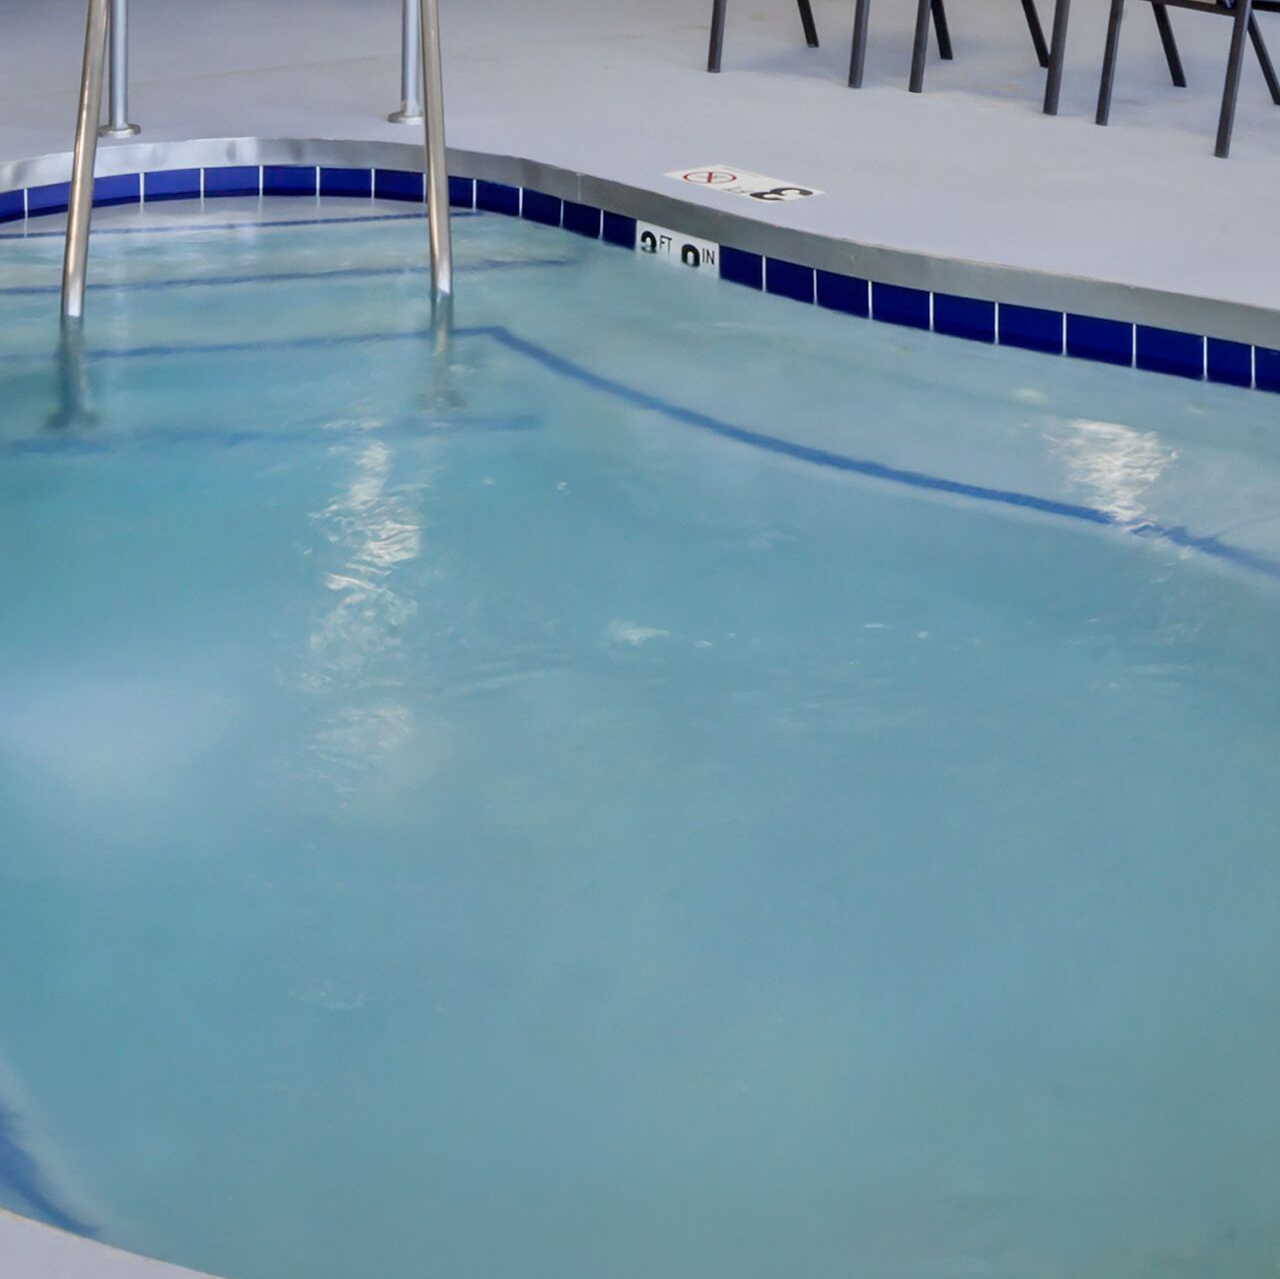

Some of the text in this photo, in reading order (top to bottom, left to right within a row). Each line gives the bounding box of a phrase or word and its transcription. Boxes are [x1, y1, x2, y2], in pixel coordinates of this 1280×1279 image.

[750, 187, 815, 202] 3
[659, 234, 673, 253] FT
[702, 247, 716, 266] IN
